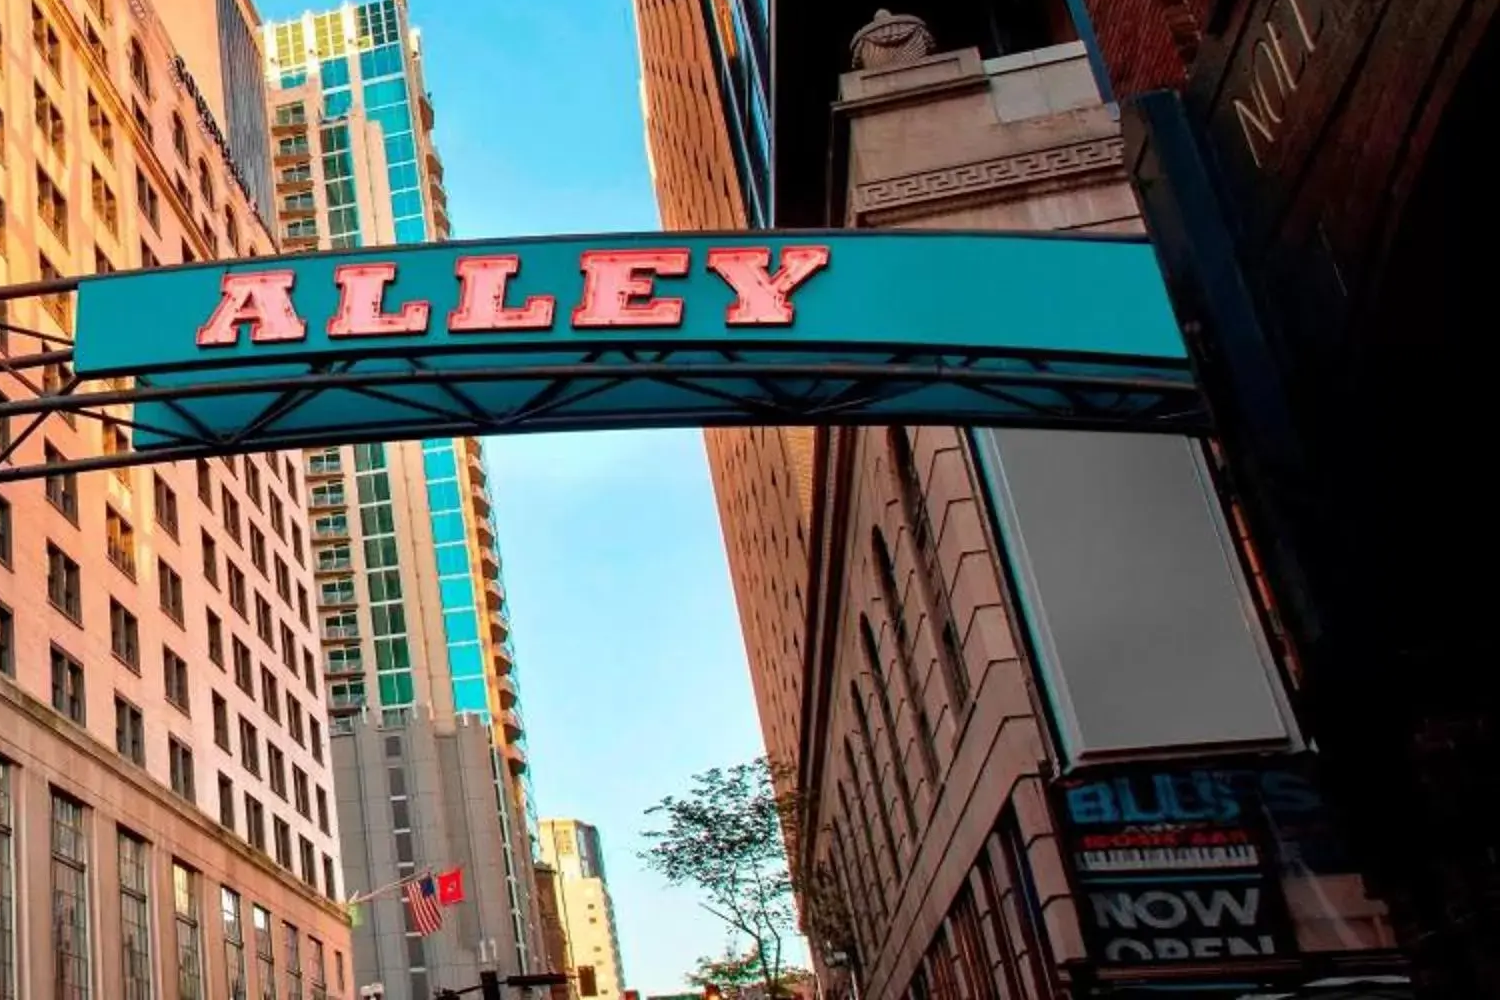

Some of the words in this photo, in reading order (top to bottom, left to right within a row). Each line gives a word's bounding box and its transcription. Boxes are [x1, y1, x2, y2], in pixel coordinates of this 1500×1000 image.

[196, 245, 830, 345] ALLEY
[1088, 887, 1260, 929] NOW
[1105, 935, 1275, 961] OPEN
